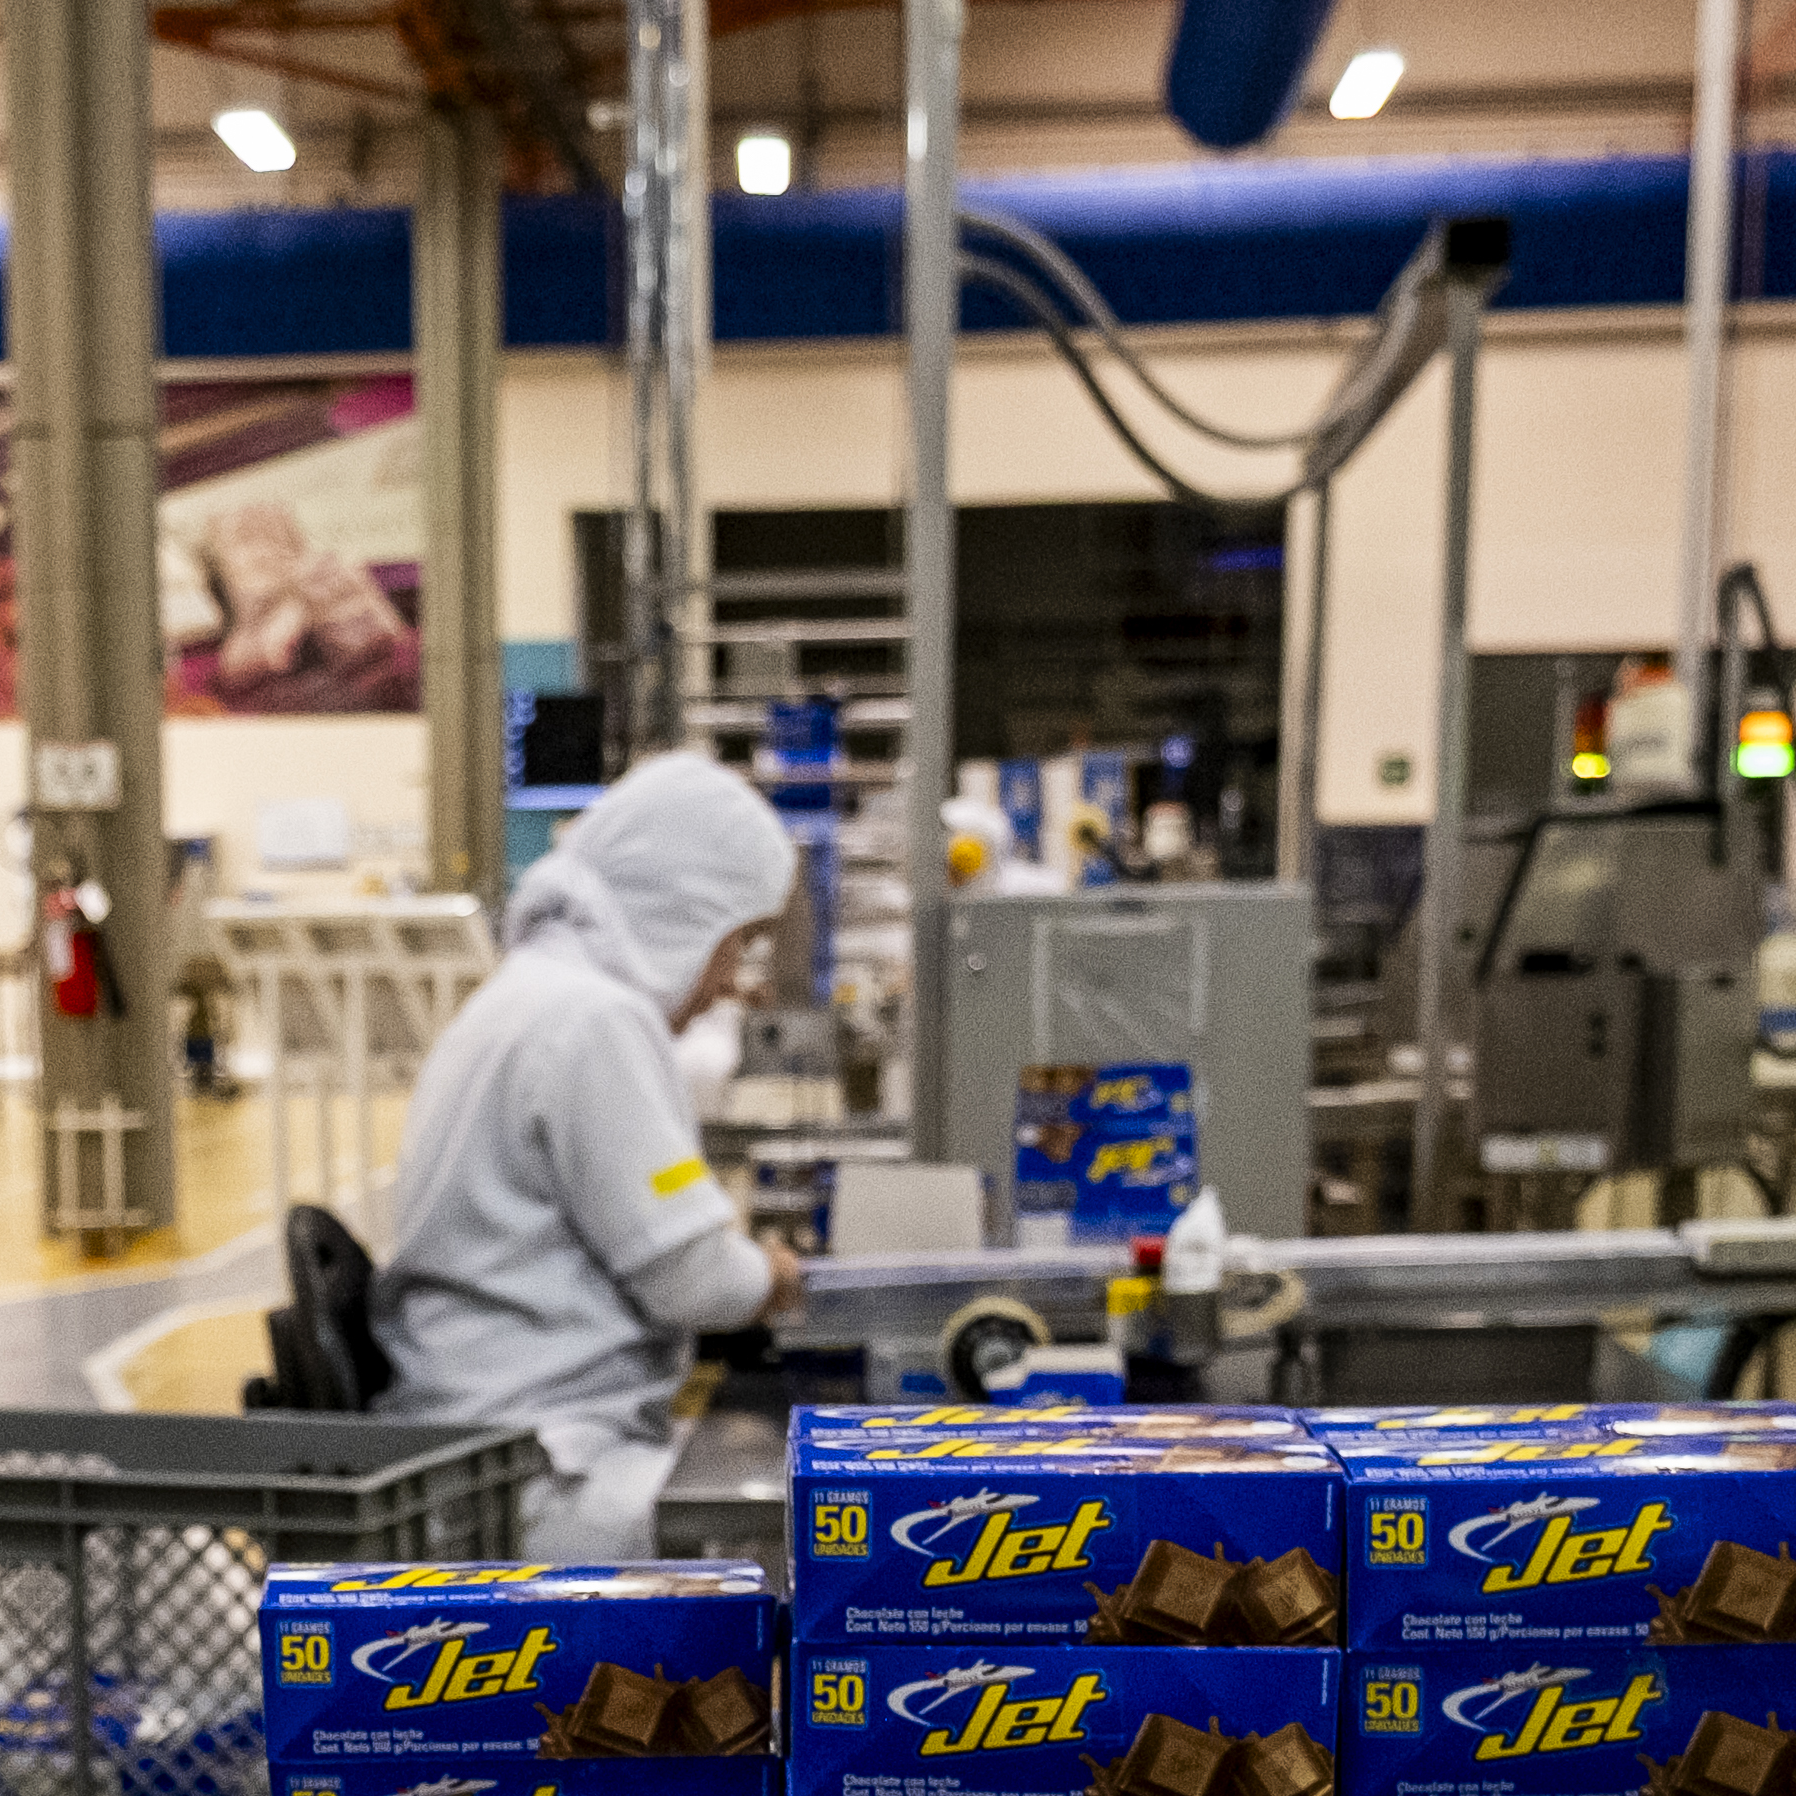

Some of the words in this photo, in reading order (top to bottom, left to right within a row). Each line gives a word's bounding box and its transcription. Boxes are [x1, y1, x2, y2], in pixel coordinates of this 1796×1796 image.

[815, 1505, 867, 1543] 50
[1371, 1512, 1424, 1550] 50
[923, 1502, 1110, 1587] Jet
[1481, 1504, 1672, 1593] Jet
[846, 1607, 904, 1620] Chocolate
[907, 1609, 929, 1620] con
[931, 1607, 964, 1620] leche
[1402, 1614, 1461, 1627] Chocolate
[1464, 1615, 1487, 1626] con
[1489, 1612, 1523, 1625] leche
[281, 1635, 330, 1671] 50
[384, 1628, 556, 1710] Jet
[813, 1674, 864, 1711] 50
[1366, 1682, 1418, 1719] 50
[920, 1675, 1106, 1756] Jet
[1474, 1674, 1662, 1761] Jet
